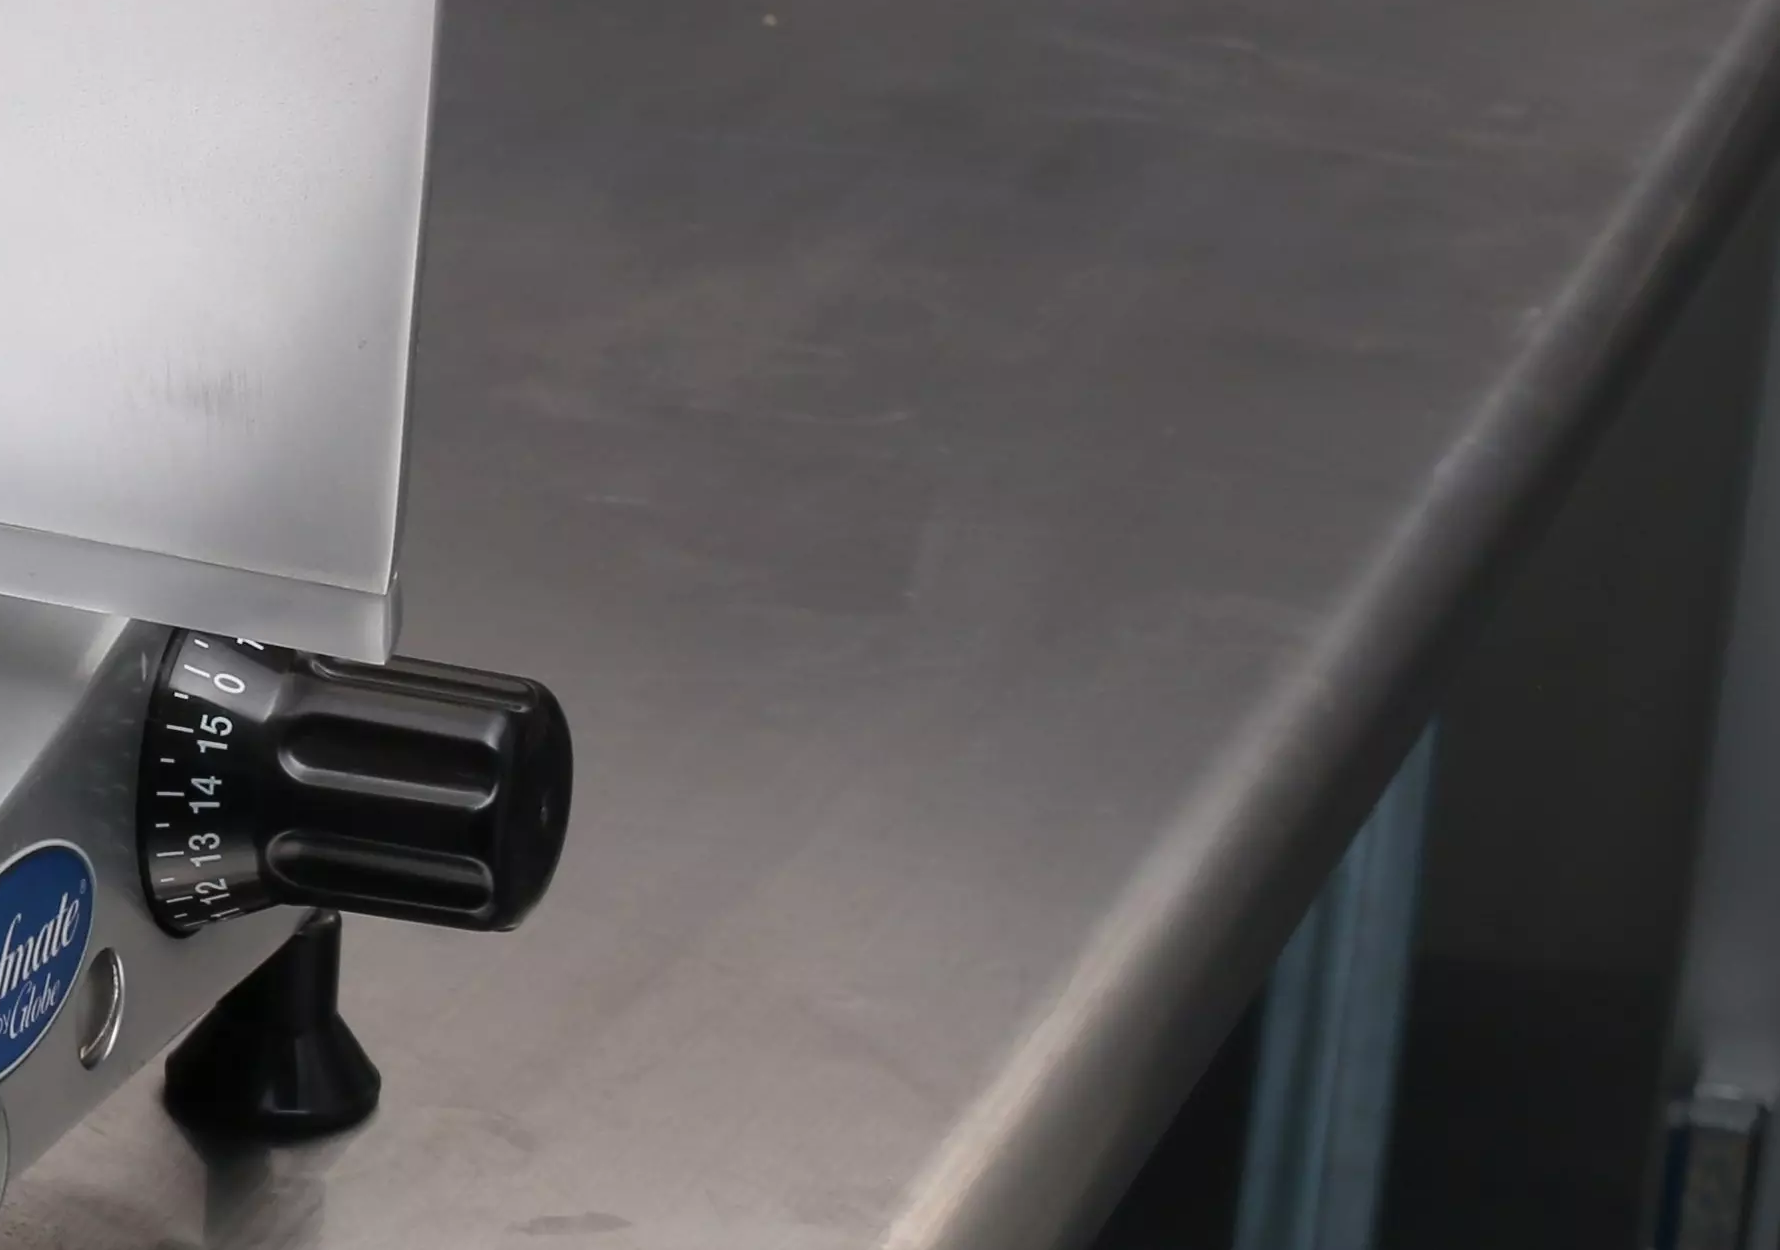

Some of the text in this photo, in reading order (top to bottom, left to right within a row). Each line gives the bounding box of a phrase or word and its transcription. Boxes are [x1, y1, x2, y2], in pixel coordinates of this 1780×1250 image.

[213, 673, 245, 694] 0
[196, 713, 233, 753] 15
[189, 775, 222, 814] 14
[188, 832, 222, 867] 13
[194, 878, 230, 905] 12
[10, 979, 60, 1040] Globe
